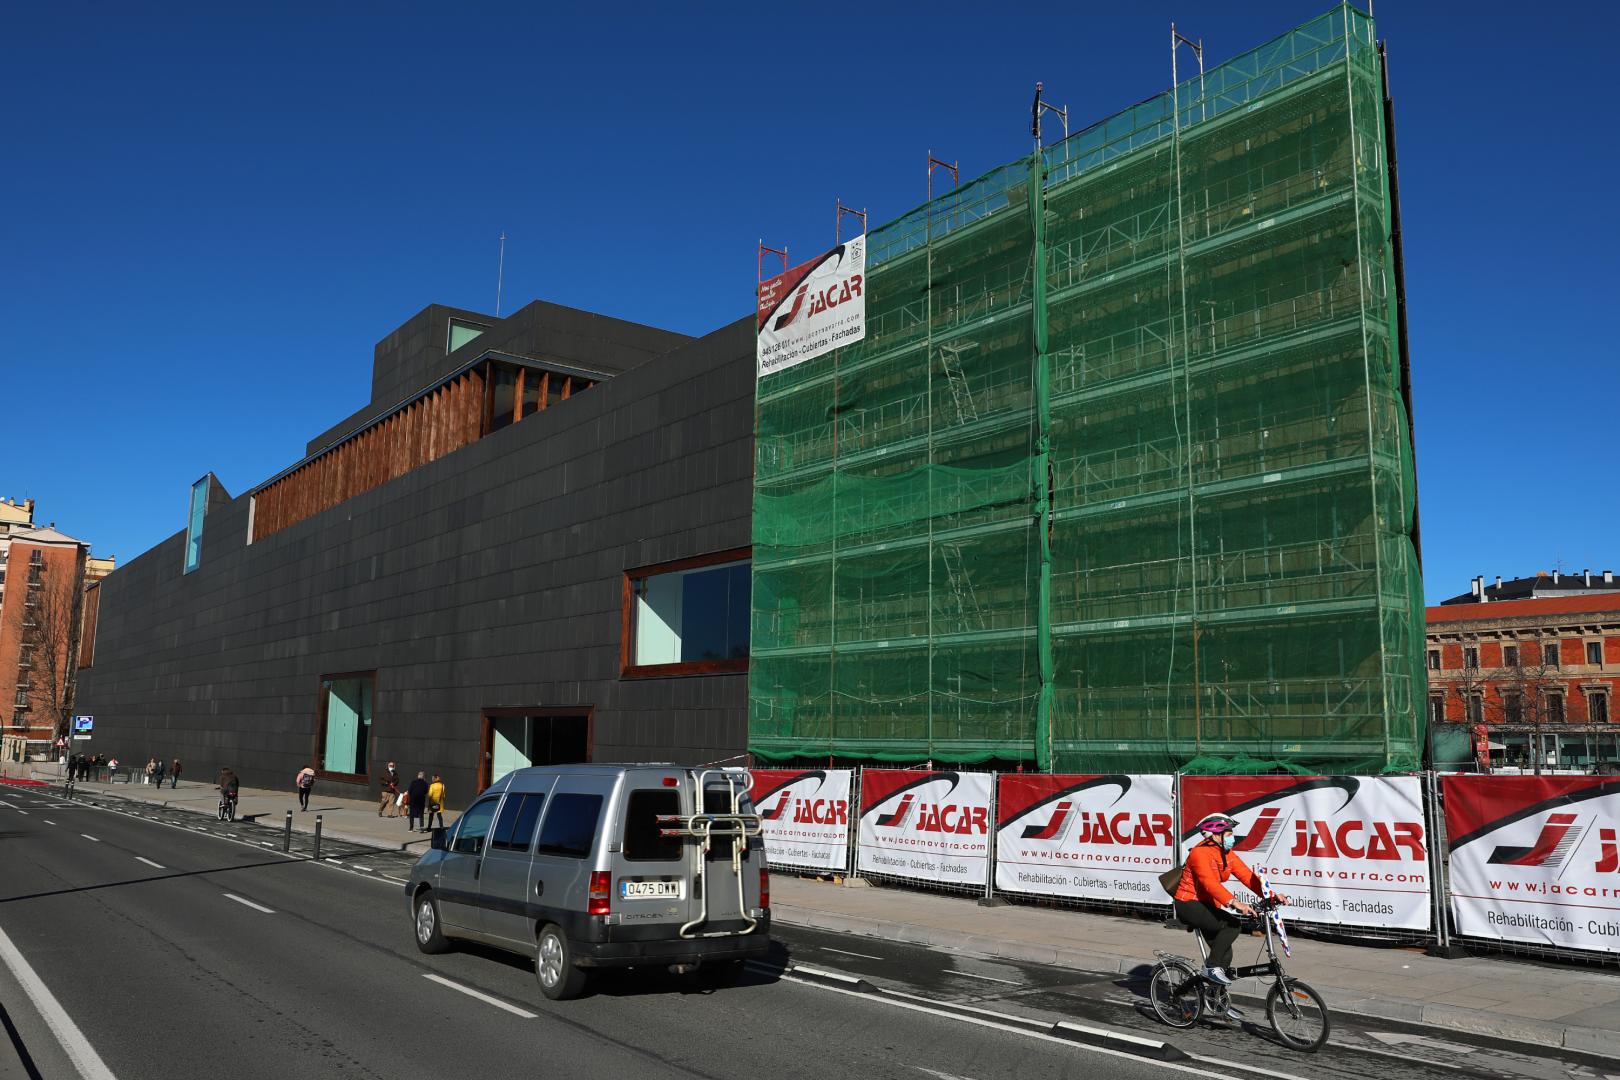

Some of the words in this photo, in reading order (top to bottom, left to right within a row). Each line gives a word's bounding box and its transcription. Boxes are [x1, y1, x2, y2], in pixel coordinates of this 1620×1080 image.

[802, 338, 828, 354] Cubiertas
[831, 325, 860, 341] Fachadas
[874, 835, 986, 850] www.jacarnavarra.com
[872, 854, 907, 867] Rehabilitación
[910, 859, 936, 871] Cubiertas
[940, 862, 968, 874] Fachadas
[1021, 850, 1172, 865] www.jacarnavarra.com
[628, 883, 655, 895] 0475
[1018, 871, 1067, 886] Rehabilitación
[1073, 876, 1108, 889] Cubiertas
[1113, 879, 1151, 892] Fachadas
[1342, 899, 1394, 915] Fachadas
[1487, 910, 1574, 933] Rehabilitación
